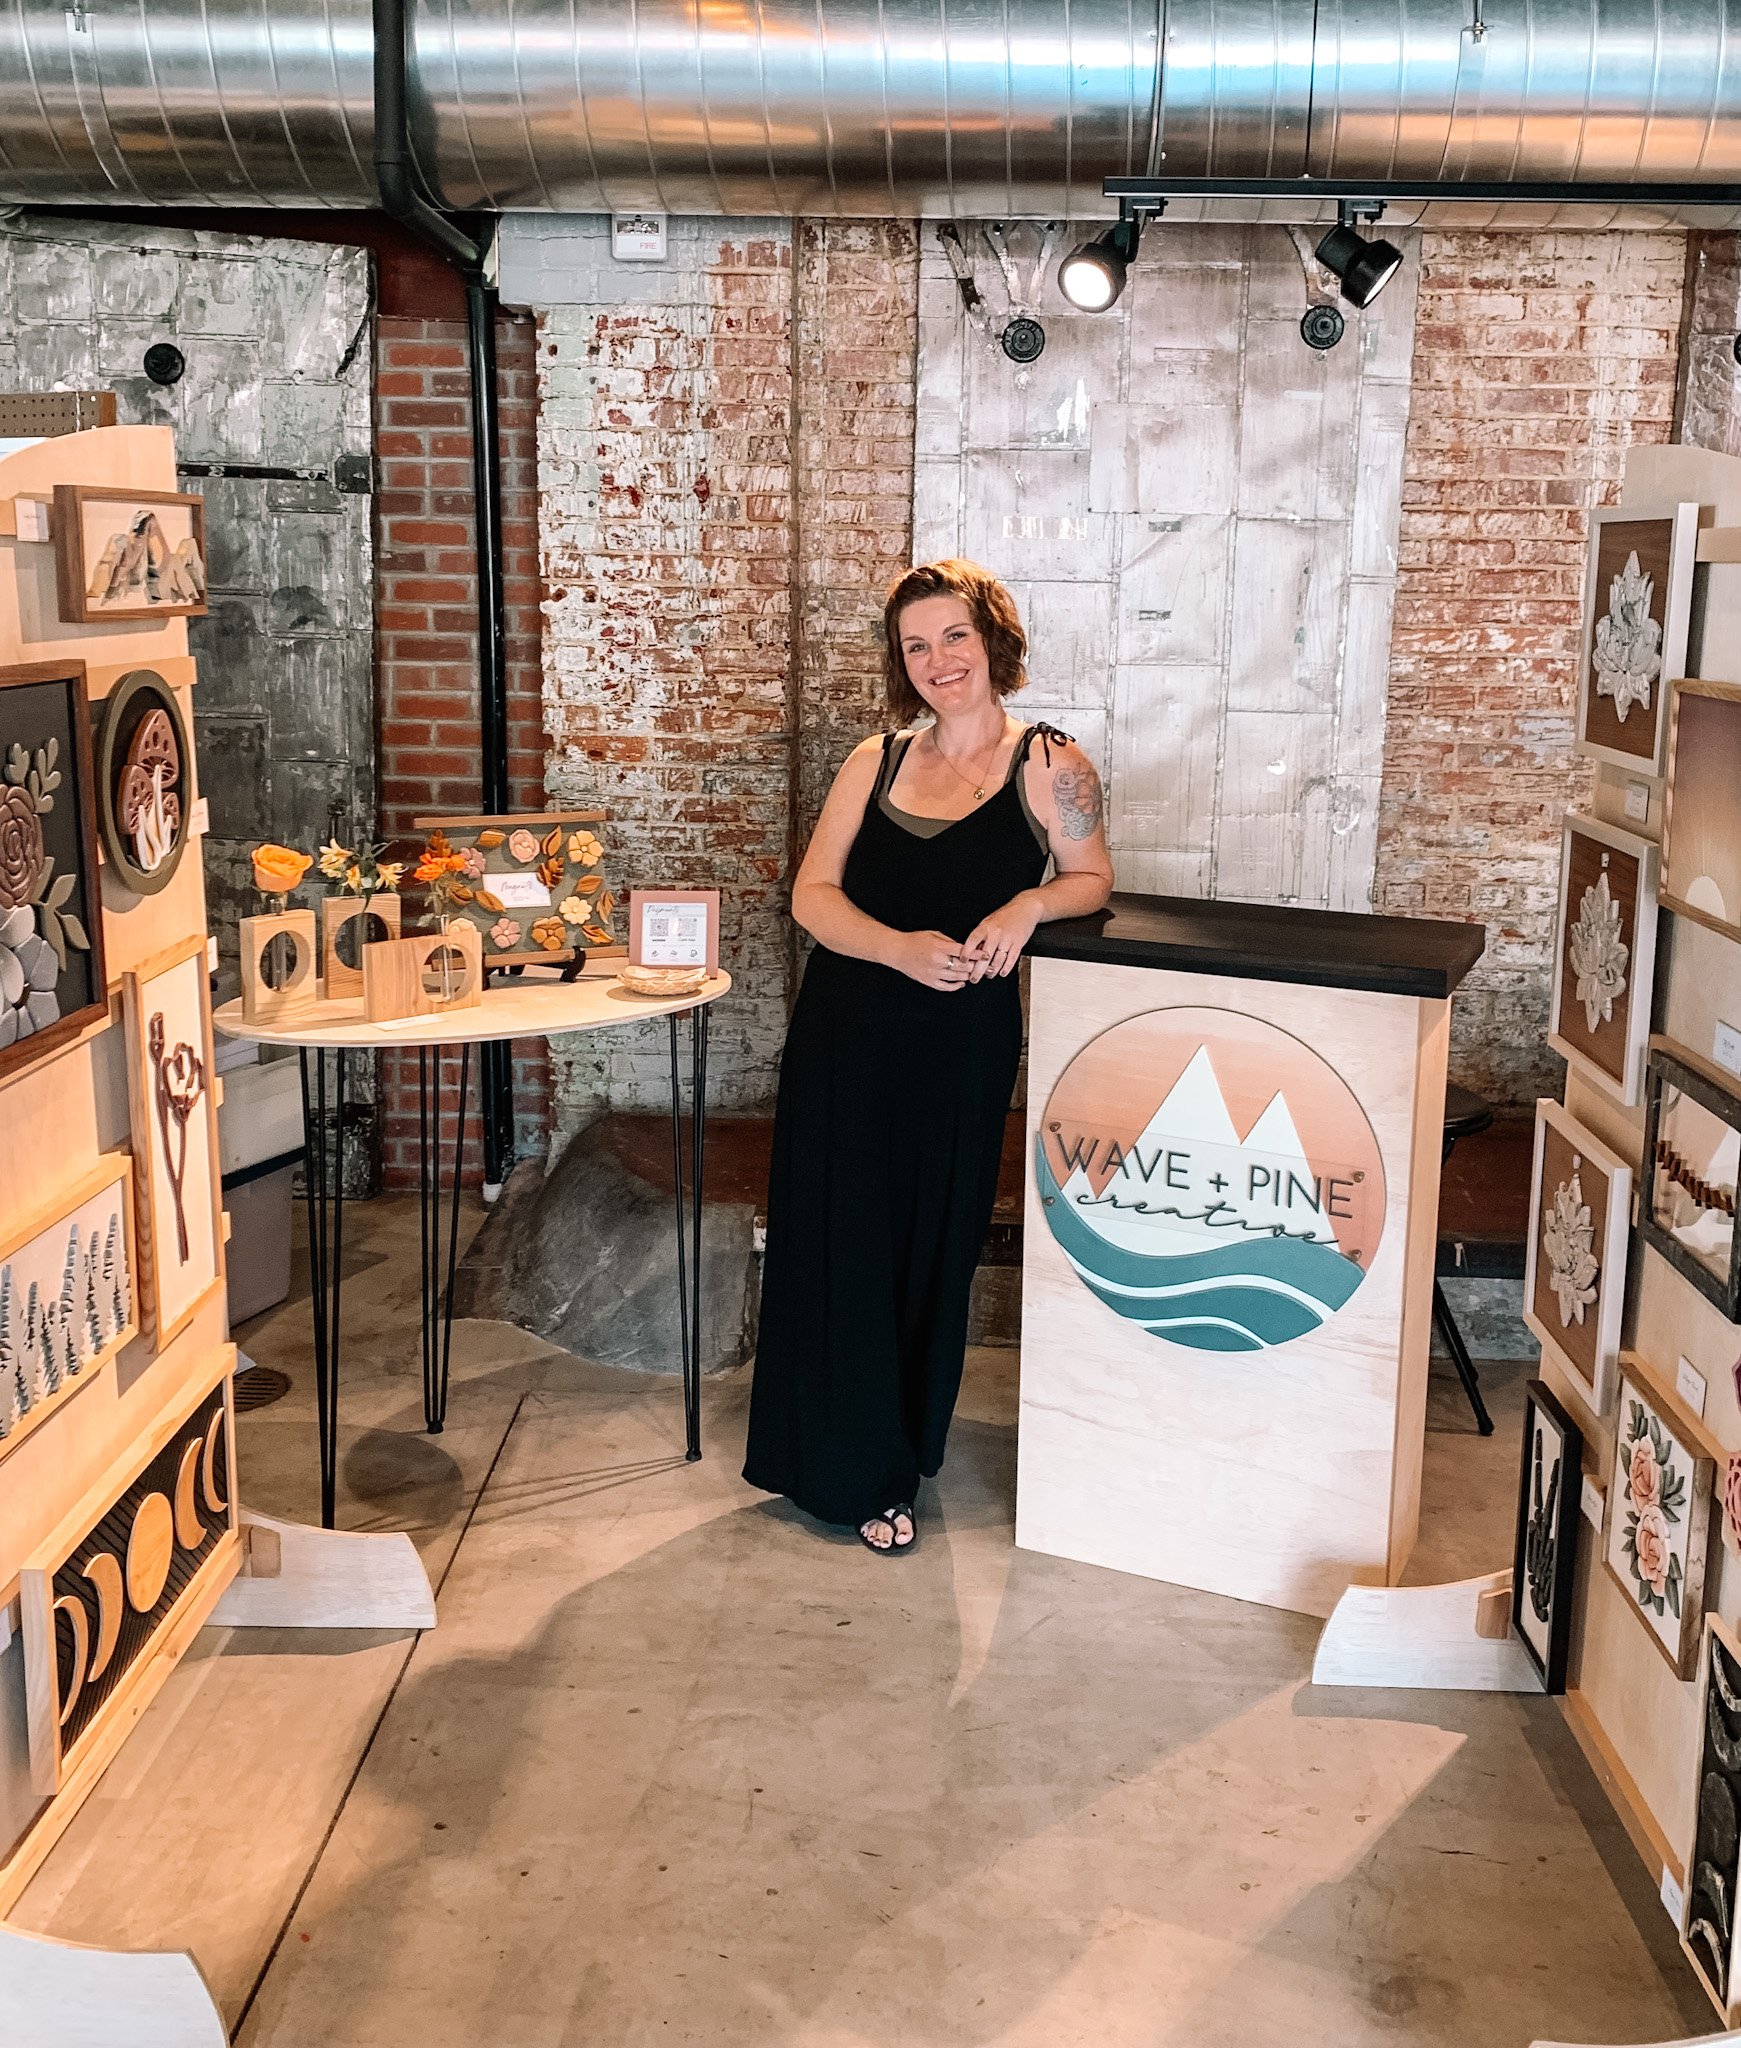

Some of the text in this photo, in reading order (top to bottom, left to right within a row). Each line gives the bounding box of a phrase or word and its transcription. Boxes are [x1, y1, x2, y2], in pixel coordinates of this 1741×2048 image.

[1055, 1133, 1355, 1219] WAVE + PINE
[1076, 1193, 1339, 1245] creative
